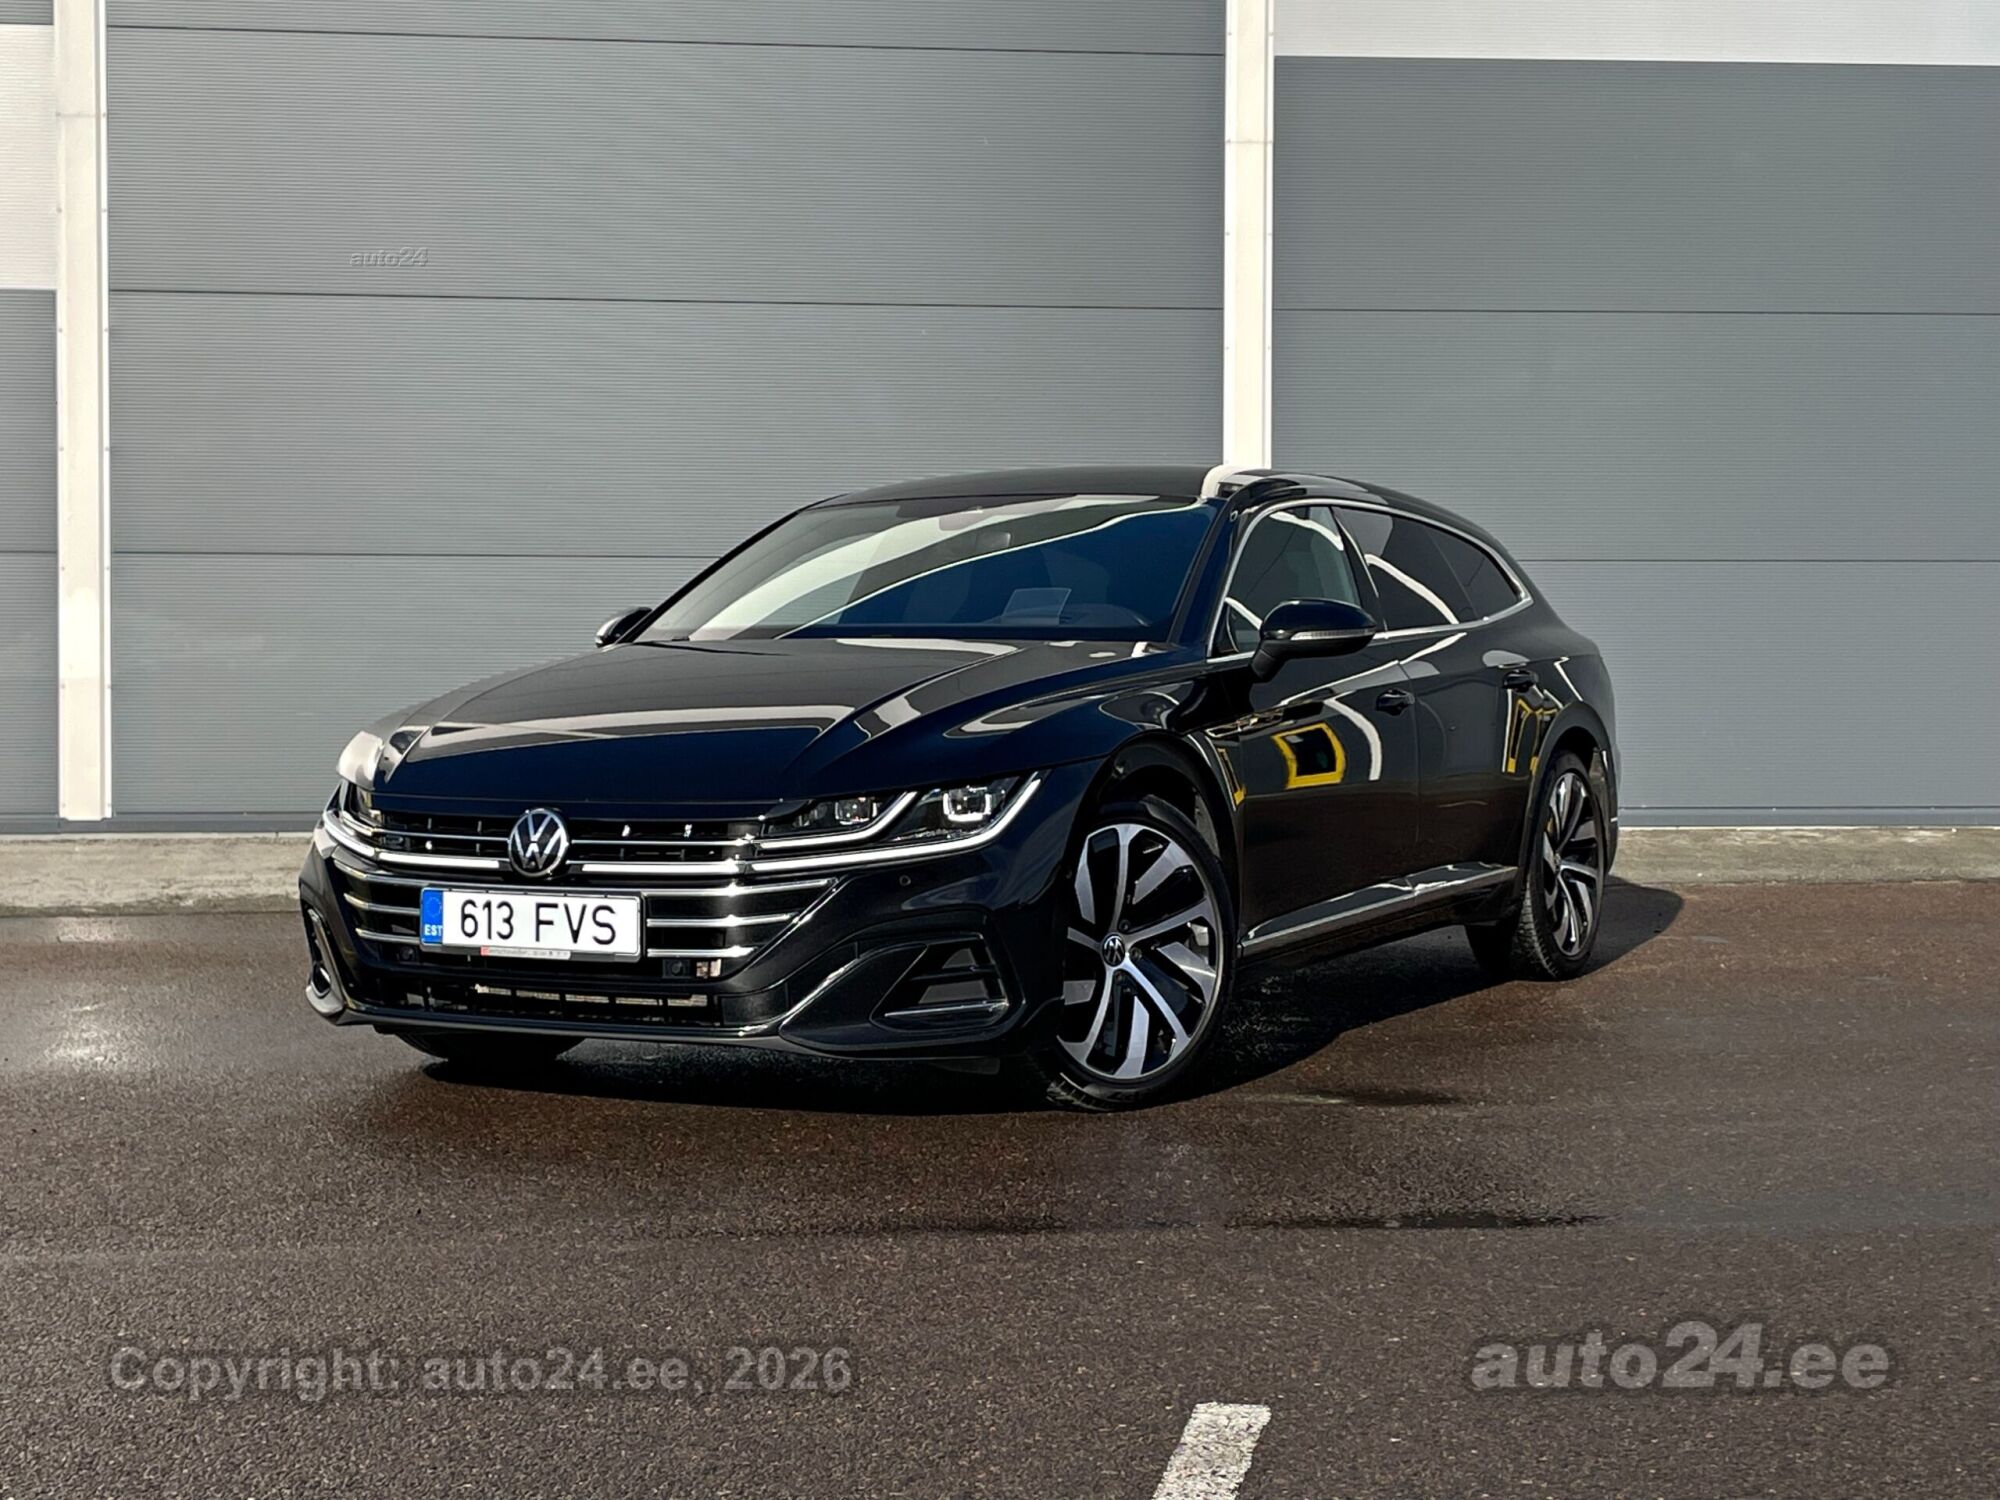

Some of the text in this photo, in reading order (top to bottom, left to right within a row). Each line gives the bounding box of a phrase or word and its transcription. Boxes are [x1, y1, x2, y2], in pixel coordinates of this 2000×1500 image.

[424, 924, 444, 936] EST
[460, 899, 616, 945] 613 FVS
